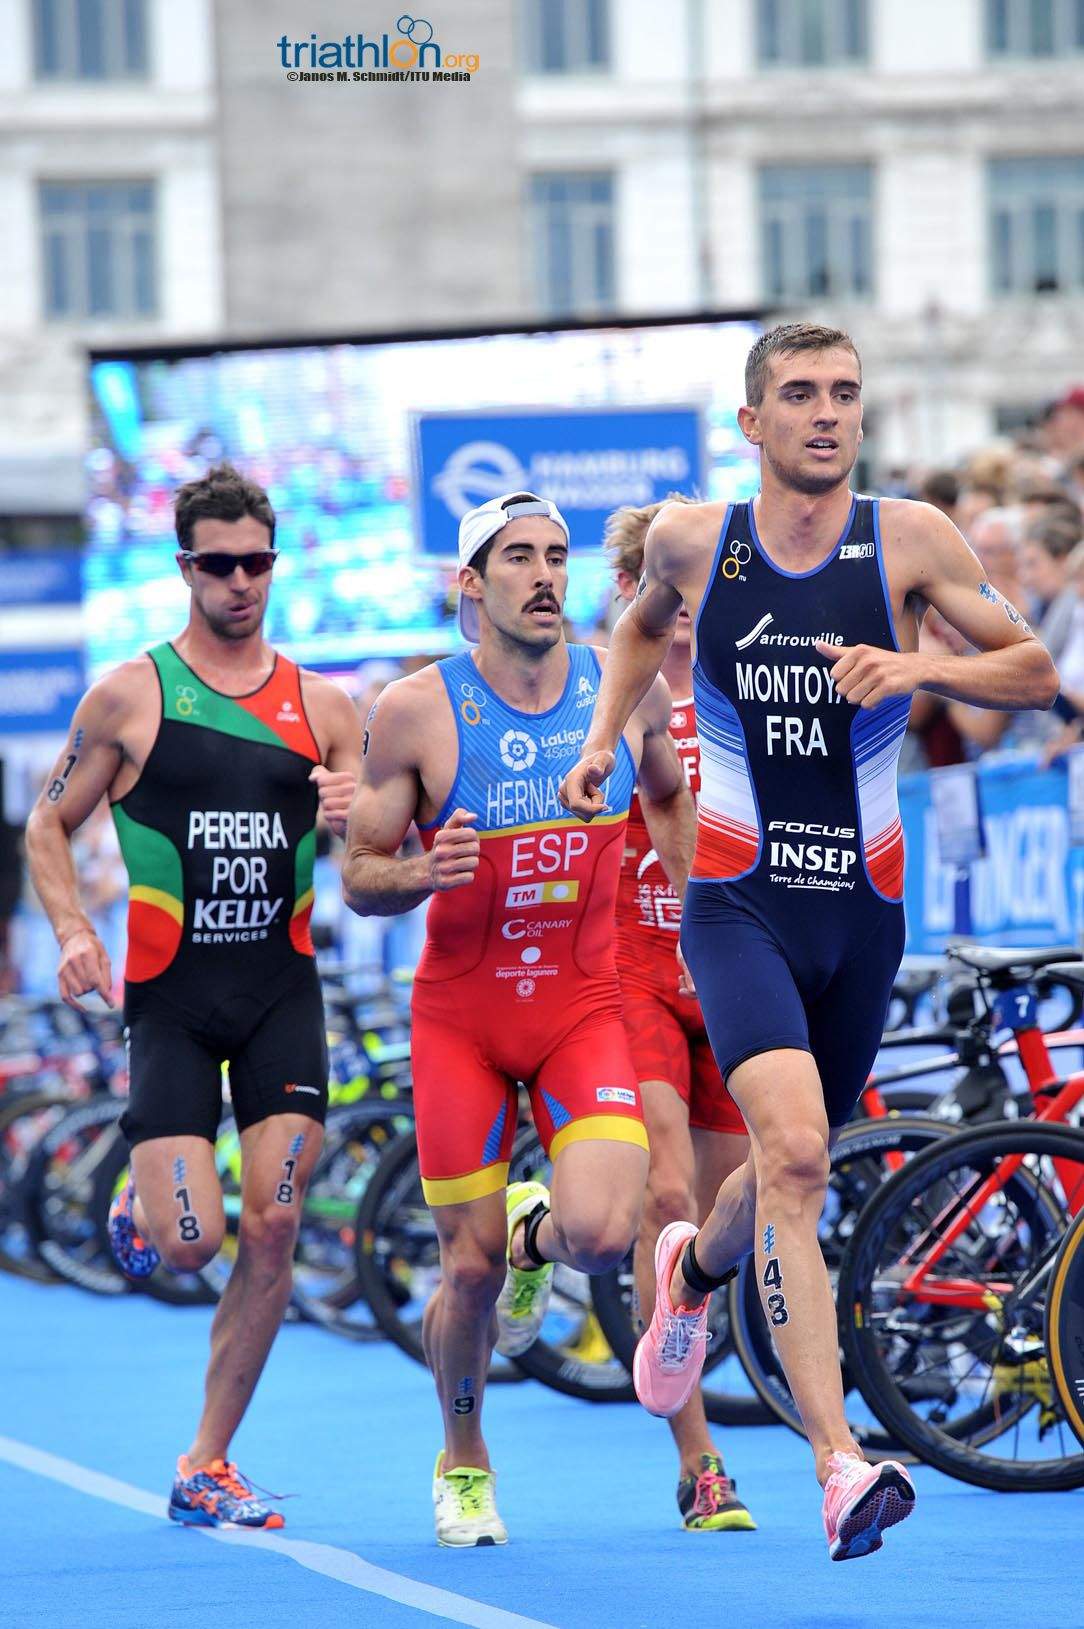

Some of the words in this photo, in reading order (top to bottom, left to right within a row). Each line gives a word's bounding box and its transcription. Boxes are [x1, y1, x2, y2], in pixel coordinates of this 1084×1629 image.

[735, 662, 851, 705] MONTOY
[540, 729, 585, 748] LaLiga
[766, 715, 829, 757] FRA
[188, 811, 288, 849] PEREIRA
[768, 820, 855, 838] FOCUS
[511, 831, 589, 879] ESP
[769, 841, 856, 875] INSEP
[212, 856, 268, 895] POR
[769, 874, 792, 884] Terre
[793, 873, 805, 884] de
[807, 876, 856, 891] Champions
[512, 889, 536, 903] TM
[193, 897, 284, 930] KELLY
[526, 919, 573, 931] CANARY
[191, 929, 268, 944] SERVICES
[526, 928, 544, 938] OIL
[495, 969, 526, 980] deporte
[526, 967, 559, 979] lagunero
[1014, 994, 1030, 1018] 7
[277, 1160, 296, 1204] 18
[175, 1187, 200, 1242] 18
[763, 1257, 789, 1327] 43
